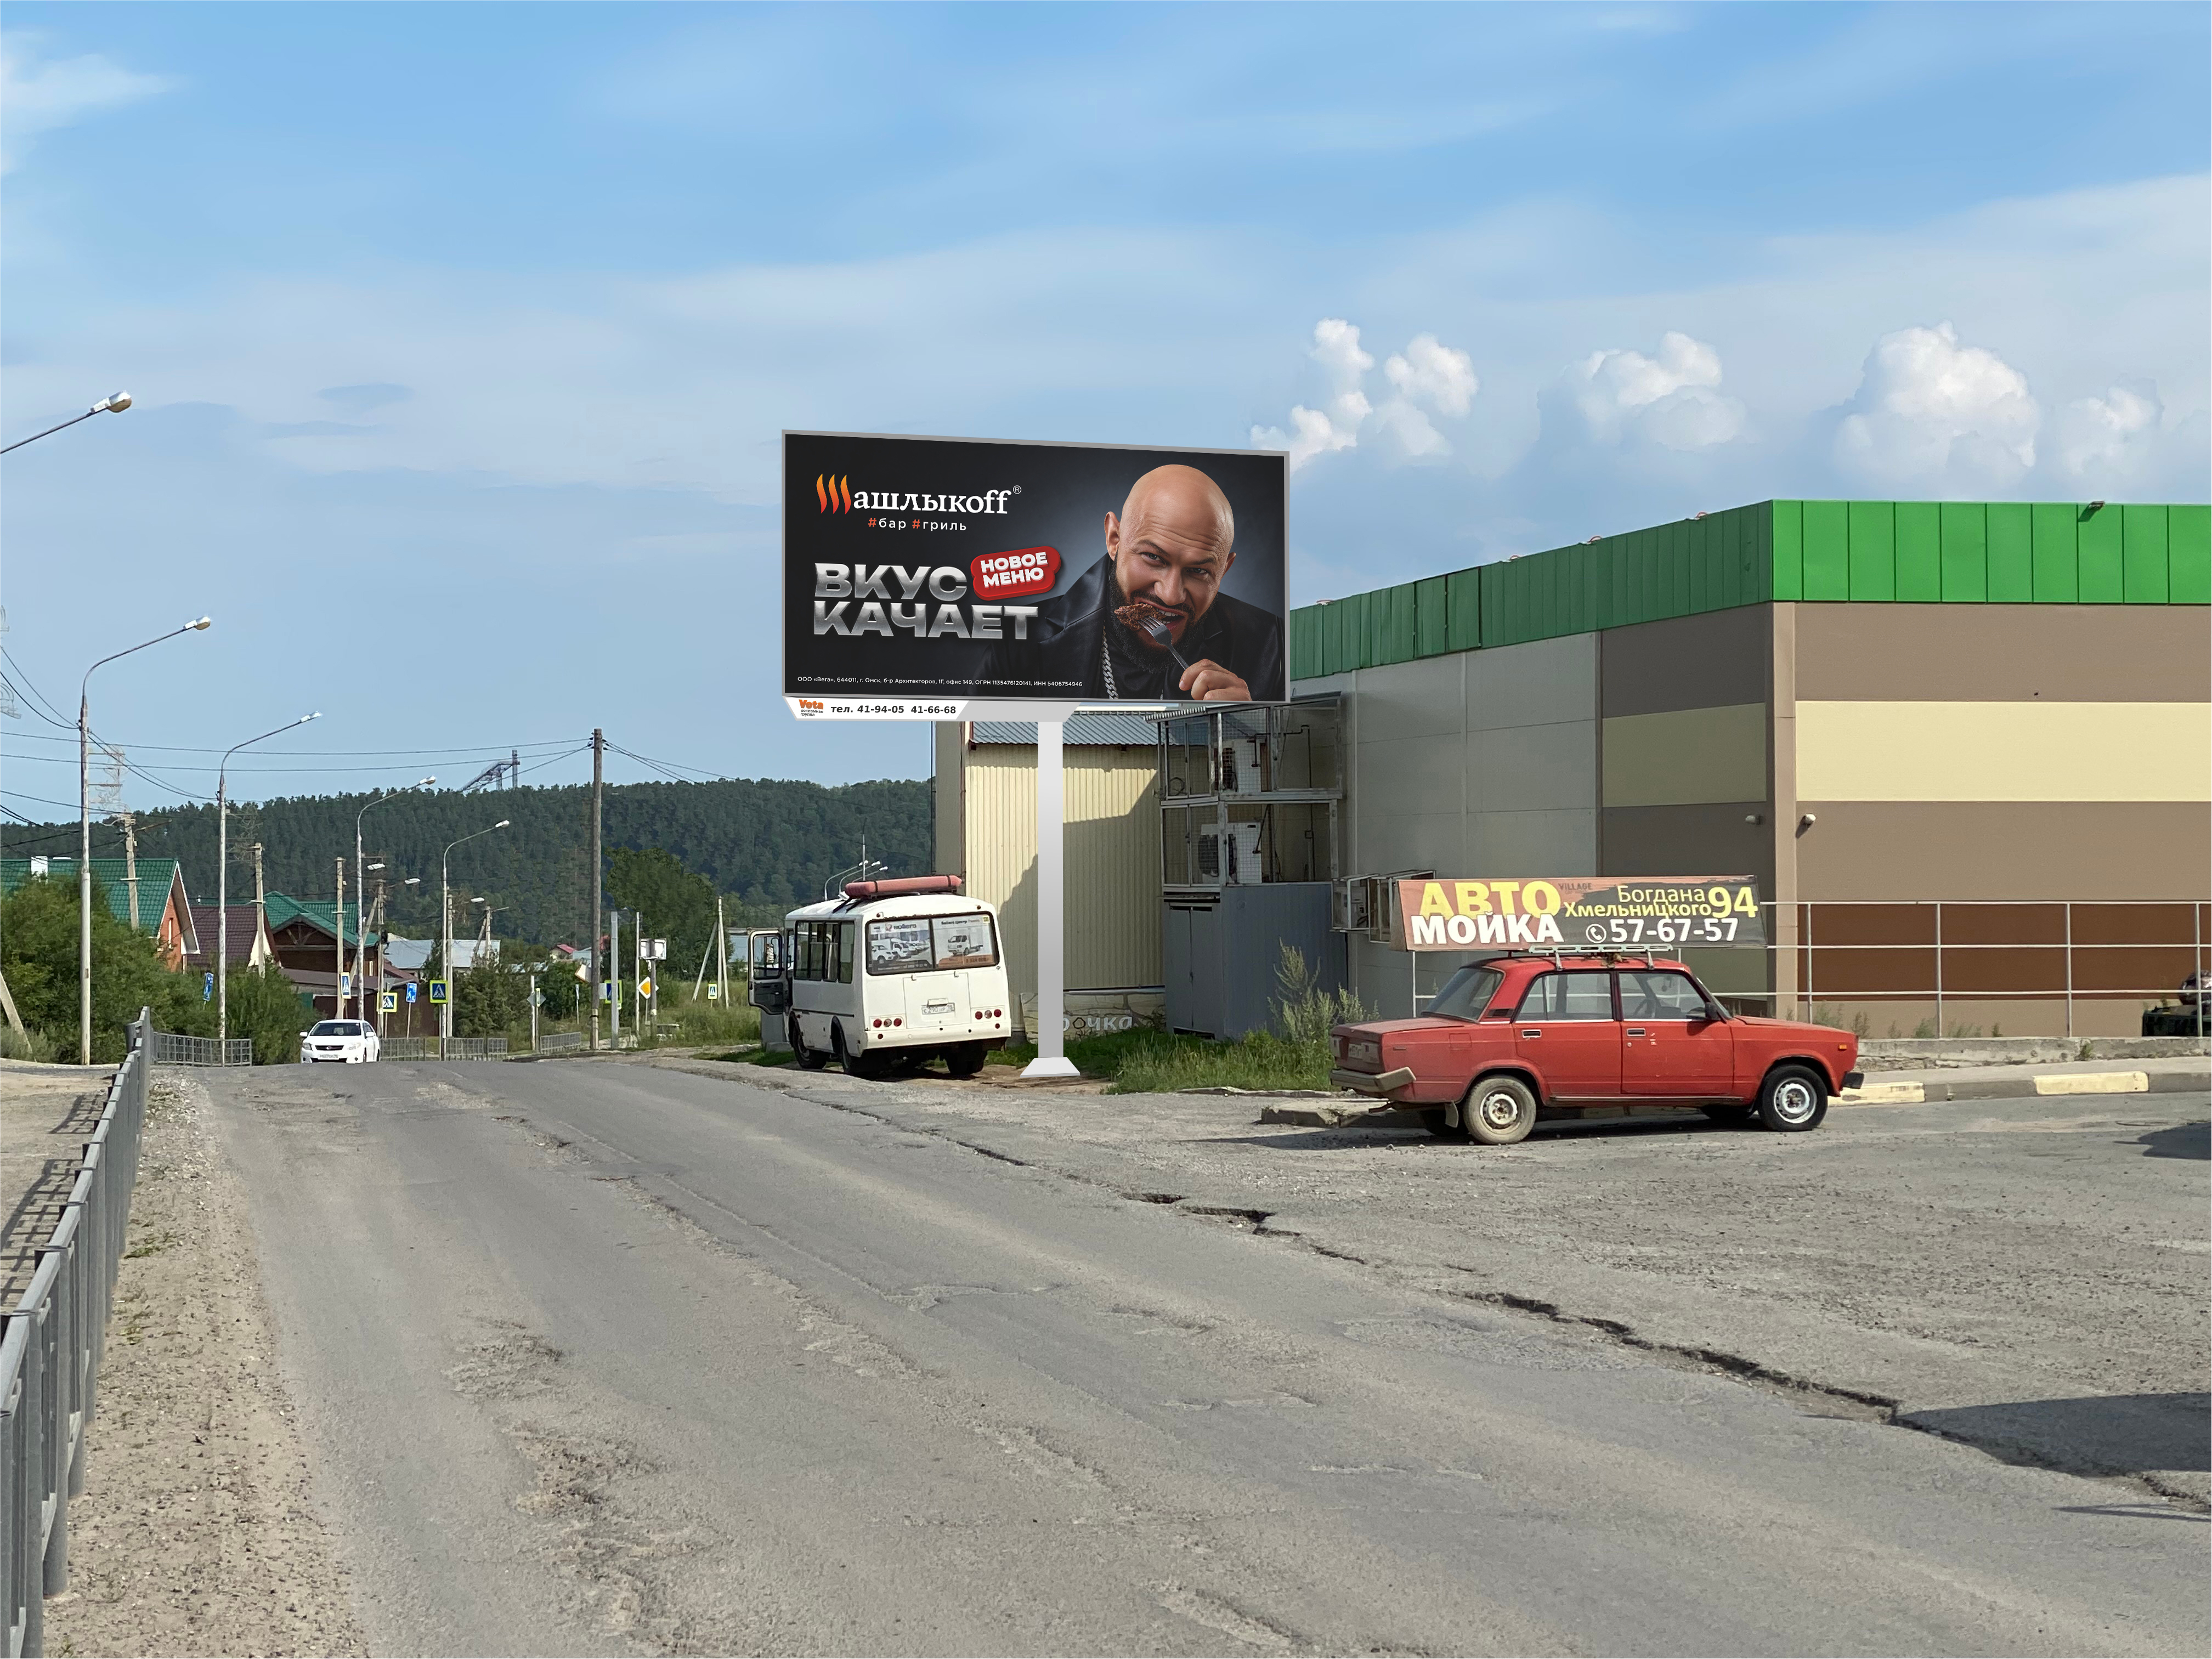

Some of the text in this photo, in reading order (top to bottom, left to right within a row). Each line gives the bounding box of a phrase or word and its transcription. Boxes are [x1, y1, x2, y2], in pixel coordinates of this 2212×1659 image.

[868, 517, 967, 531] #бар #гриль
[980, 552, 1048, 574] НОВОЕ
[814, 563, 968, 602] ВКУС
[983, 567, 1044, 588] МЕНЮ
[813, 600, 1039, 639] КАЧАЕТ
[799, 699, 824, 710] Vota
[857, 705, 904, 714] 41-94-05
[910, 706, 956, 714] 41-66-68
[1419, 881, 1561, 920] АВТО
[1563, 886, 1758, 919] Хмельницкого 94
[1617, 885, 1705, 905] Богдана
[1411, 910, 1564, 944] МОЙКА
[1610, 918, 1739, 943] 57-67-57
